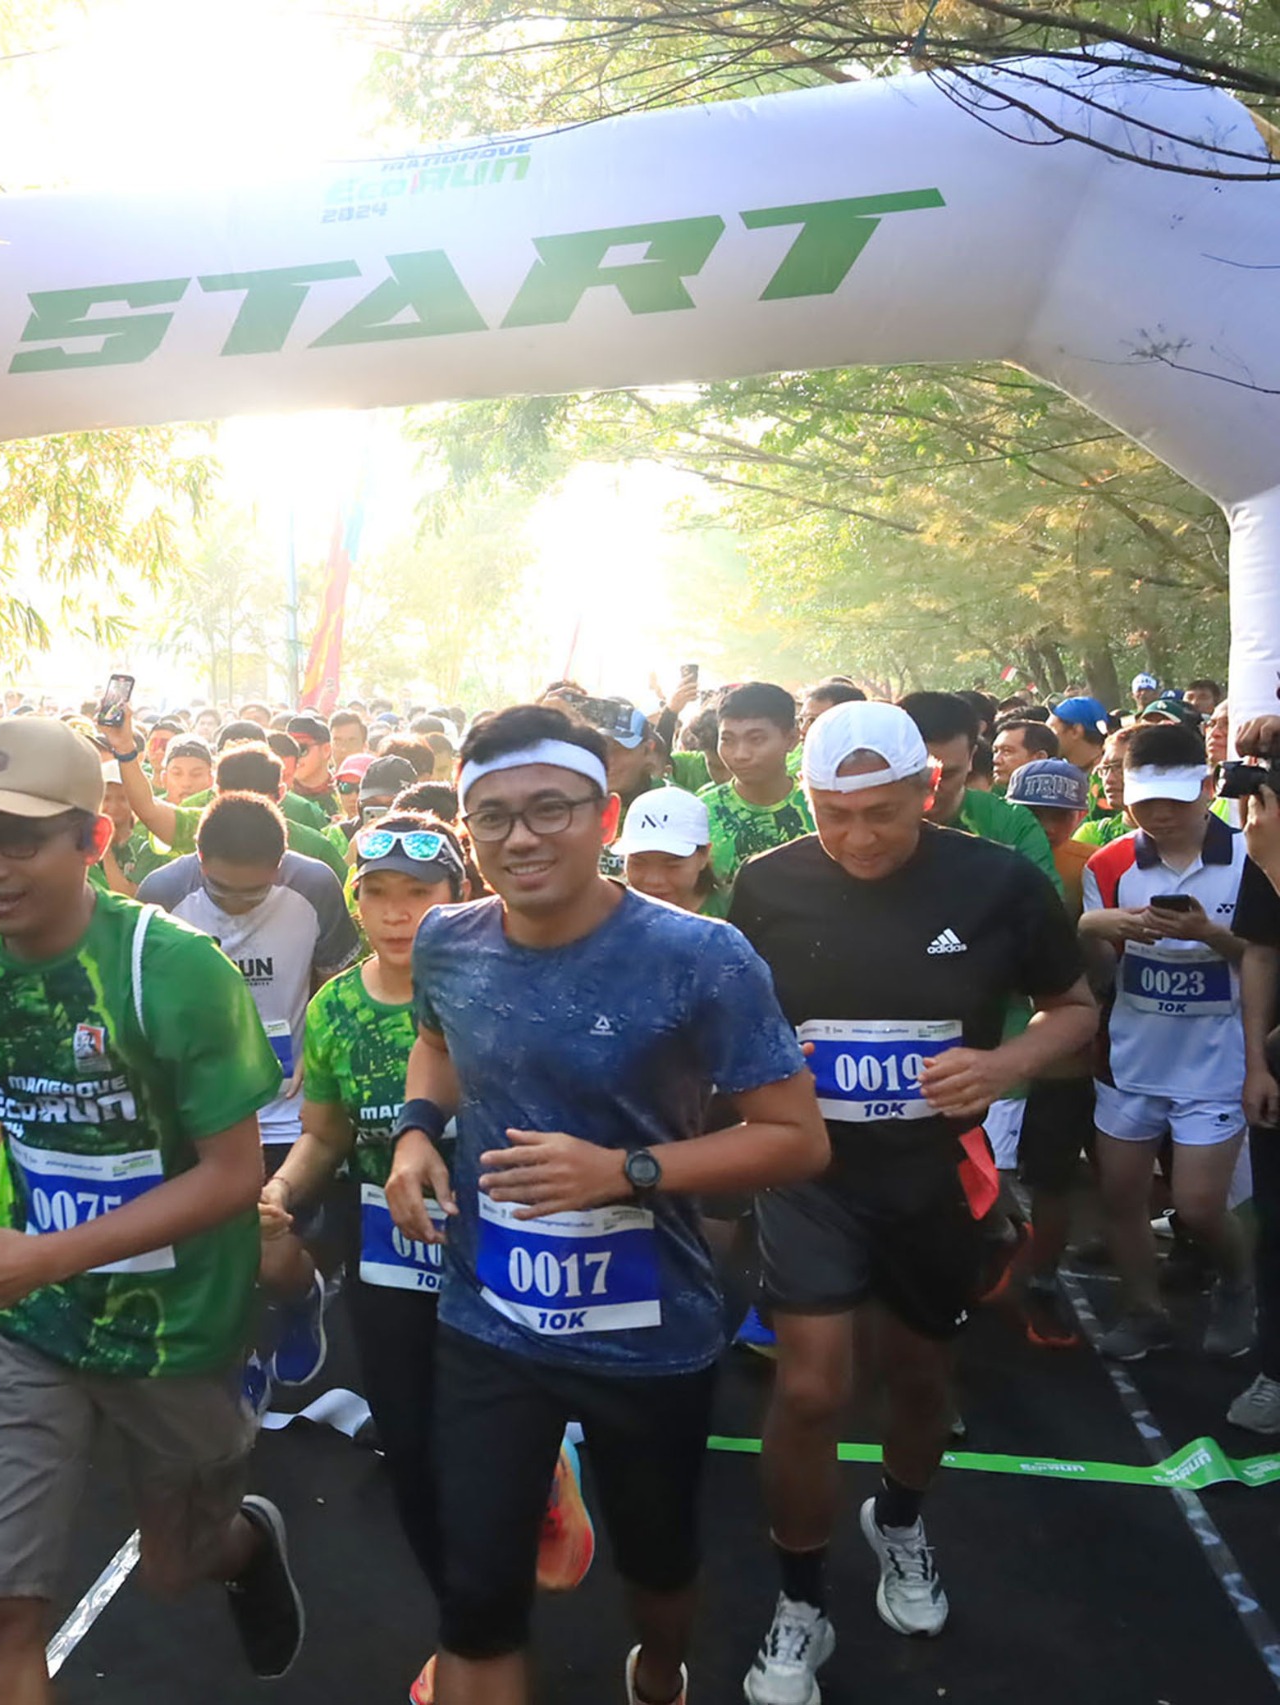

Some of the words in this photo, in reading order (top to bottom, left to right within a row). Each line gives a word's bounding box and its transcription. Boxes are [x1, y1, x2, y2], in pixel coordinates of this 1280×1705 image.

[321, 202, 389, 224] 2024
[6, 187, 948, 374] START
[1024, 773, 1080, 803] TRUE
[926, 943, 968, 956] adidas
[1141, 966, 1206, 996] 0023
[1157, 1002, 1188, 1014] 10K
[834, 1052, 923, 1093] 0019
[863, 1102, 907, 1117] 10K
[417, 1272, 442, 1290] 10
[508, 1246, 612, 1298] 0017
[538, 1310, 589, 1330] 10K
